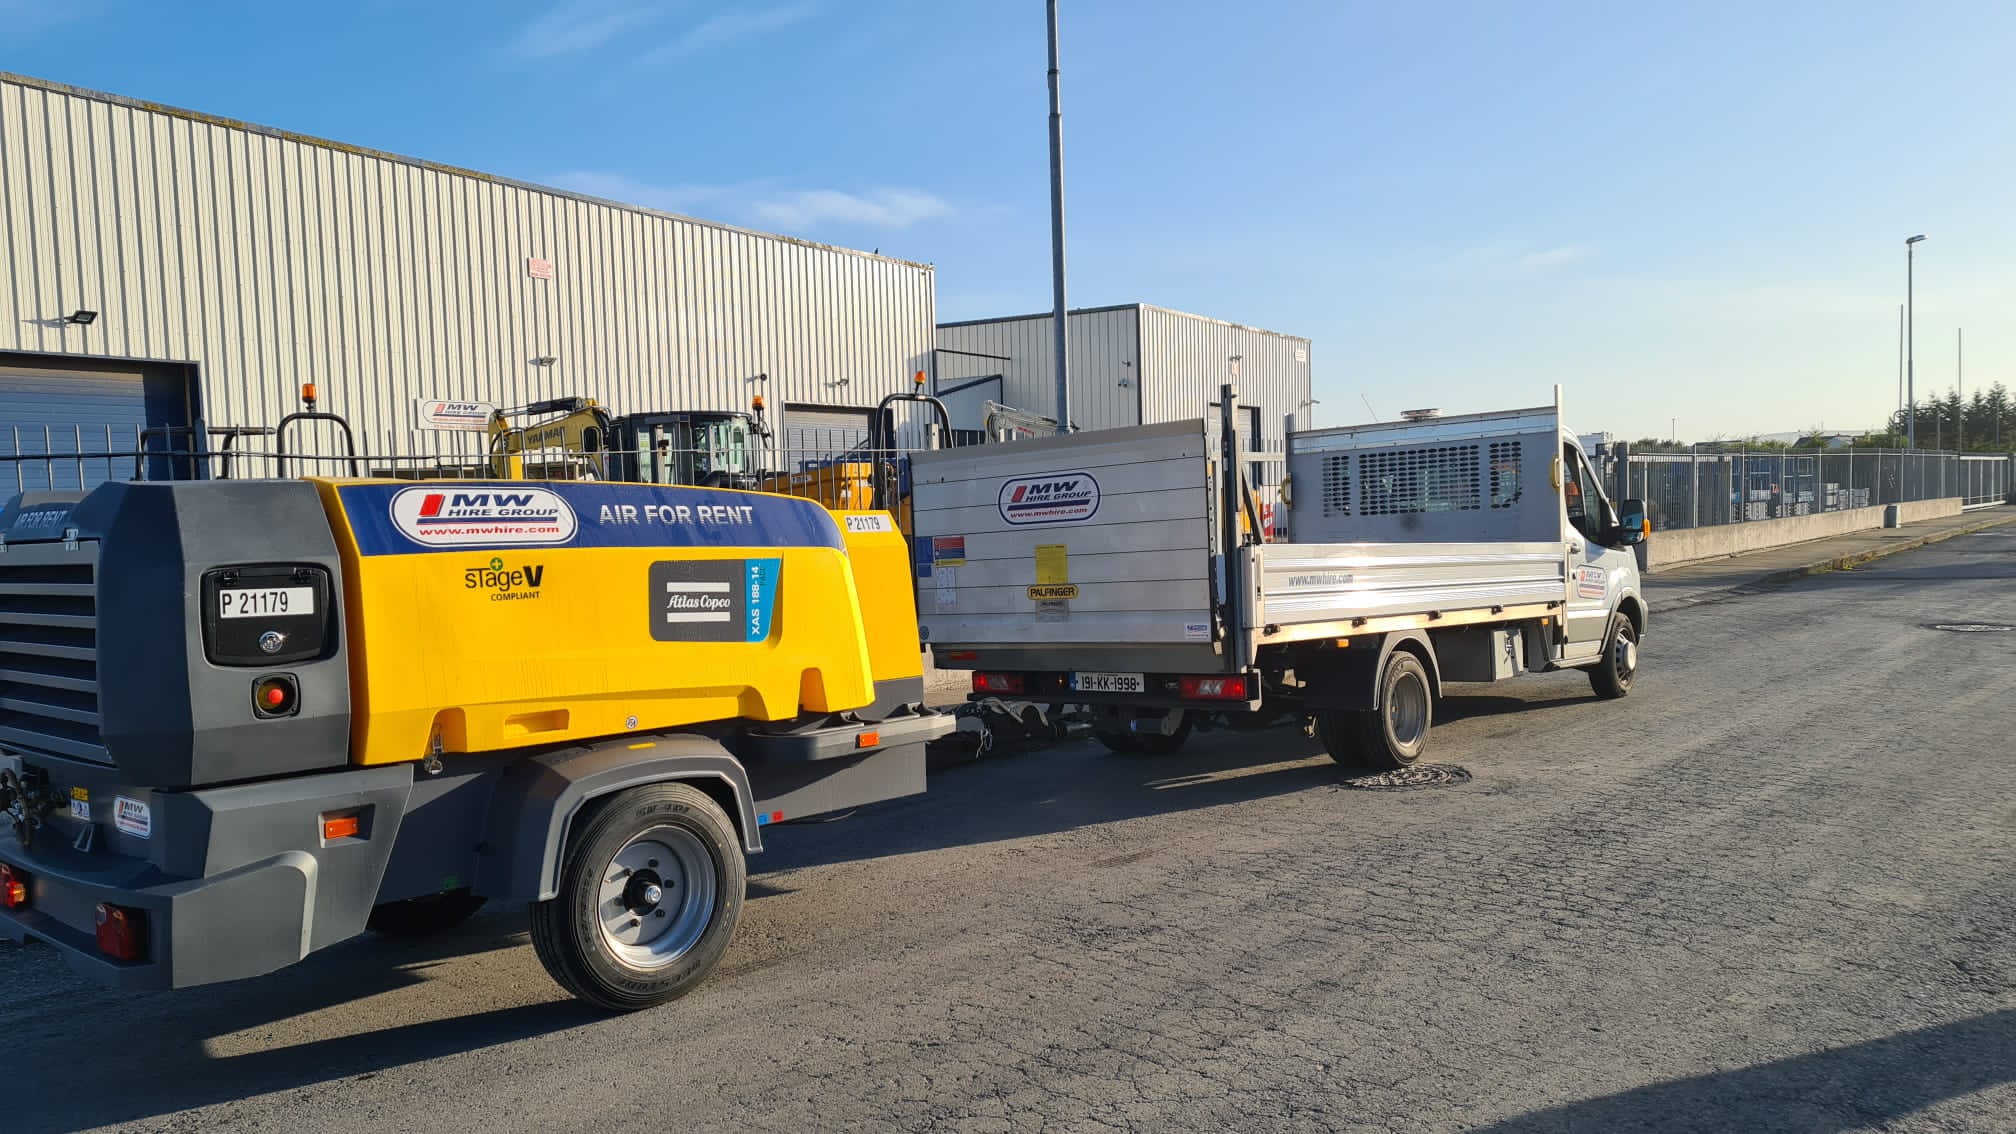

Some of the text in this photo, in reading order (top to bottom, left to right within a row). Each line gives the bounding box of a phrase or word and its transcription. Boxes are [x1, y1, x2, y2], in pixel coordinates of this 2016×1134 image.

[1029, 481, 1080, 494] MW
[451, 494, 534, 507] MW
[1025, 491, 1092, 502] HIRE GROUP
[448, 508, 559, 517] HIRE GROUP
[600, 504, 753, 526] AIR FOR RENT
[1010, 508, 1088, 519] www.mwhire.com
[419, 525, 560, 536] www.mwhire.com
[846, 517, 881, 531] P 21179
[1288, 572, 1354, 587] www.mwhire.com
[490, 591, 541, 602] COMPLIANT
[1030, 586, 1075, 598] PALFINGER
[222, 591, 289, 615] P 21179
[667, 594, 731, 611] Atlas Copco
[751, 608, 760, 635] XAS
[1081, 675, 1137, 691] 191-KK-1998
[124, 802, 144, 813] MW
